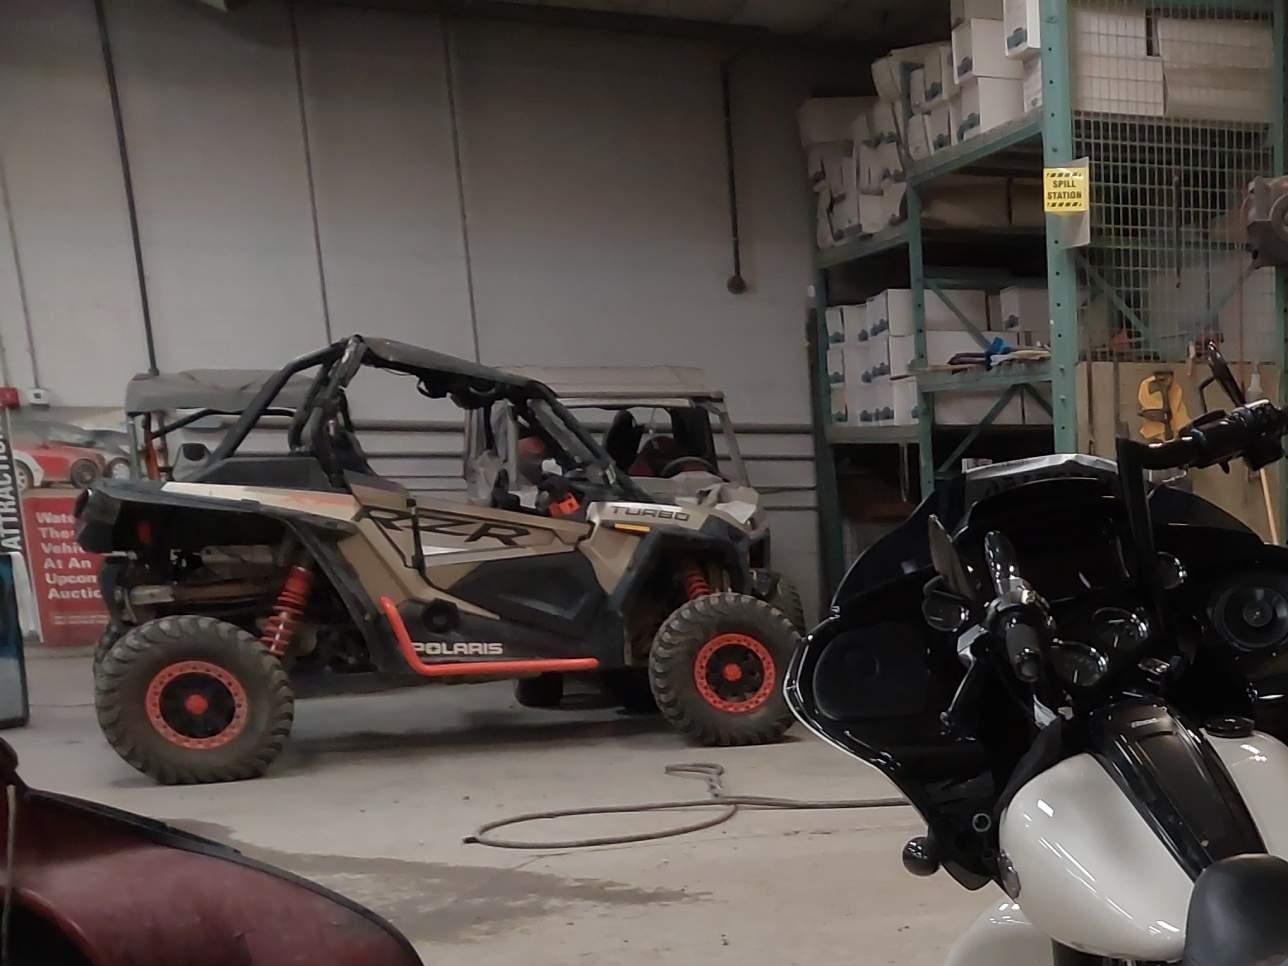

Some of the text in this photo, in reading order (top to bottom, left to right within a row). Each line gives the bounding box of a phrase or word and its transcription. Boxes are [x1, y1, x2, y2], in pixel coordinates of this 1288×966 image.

[1052, 180, 1076, 188] SPILL
[1047, 191, 1082, 200] STATION
[610, 505, 691, 521] TURBO
[352, 504, 531, 550] RZR
[44, 558, 91, 569] At An
[411, 642, 503, 655] POLARIS
